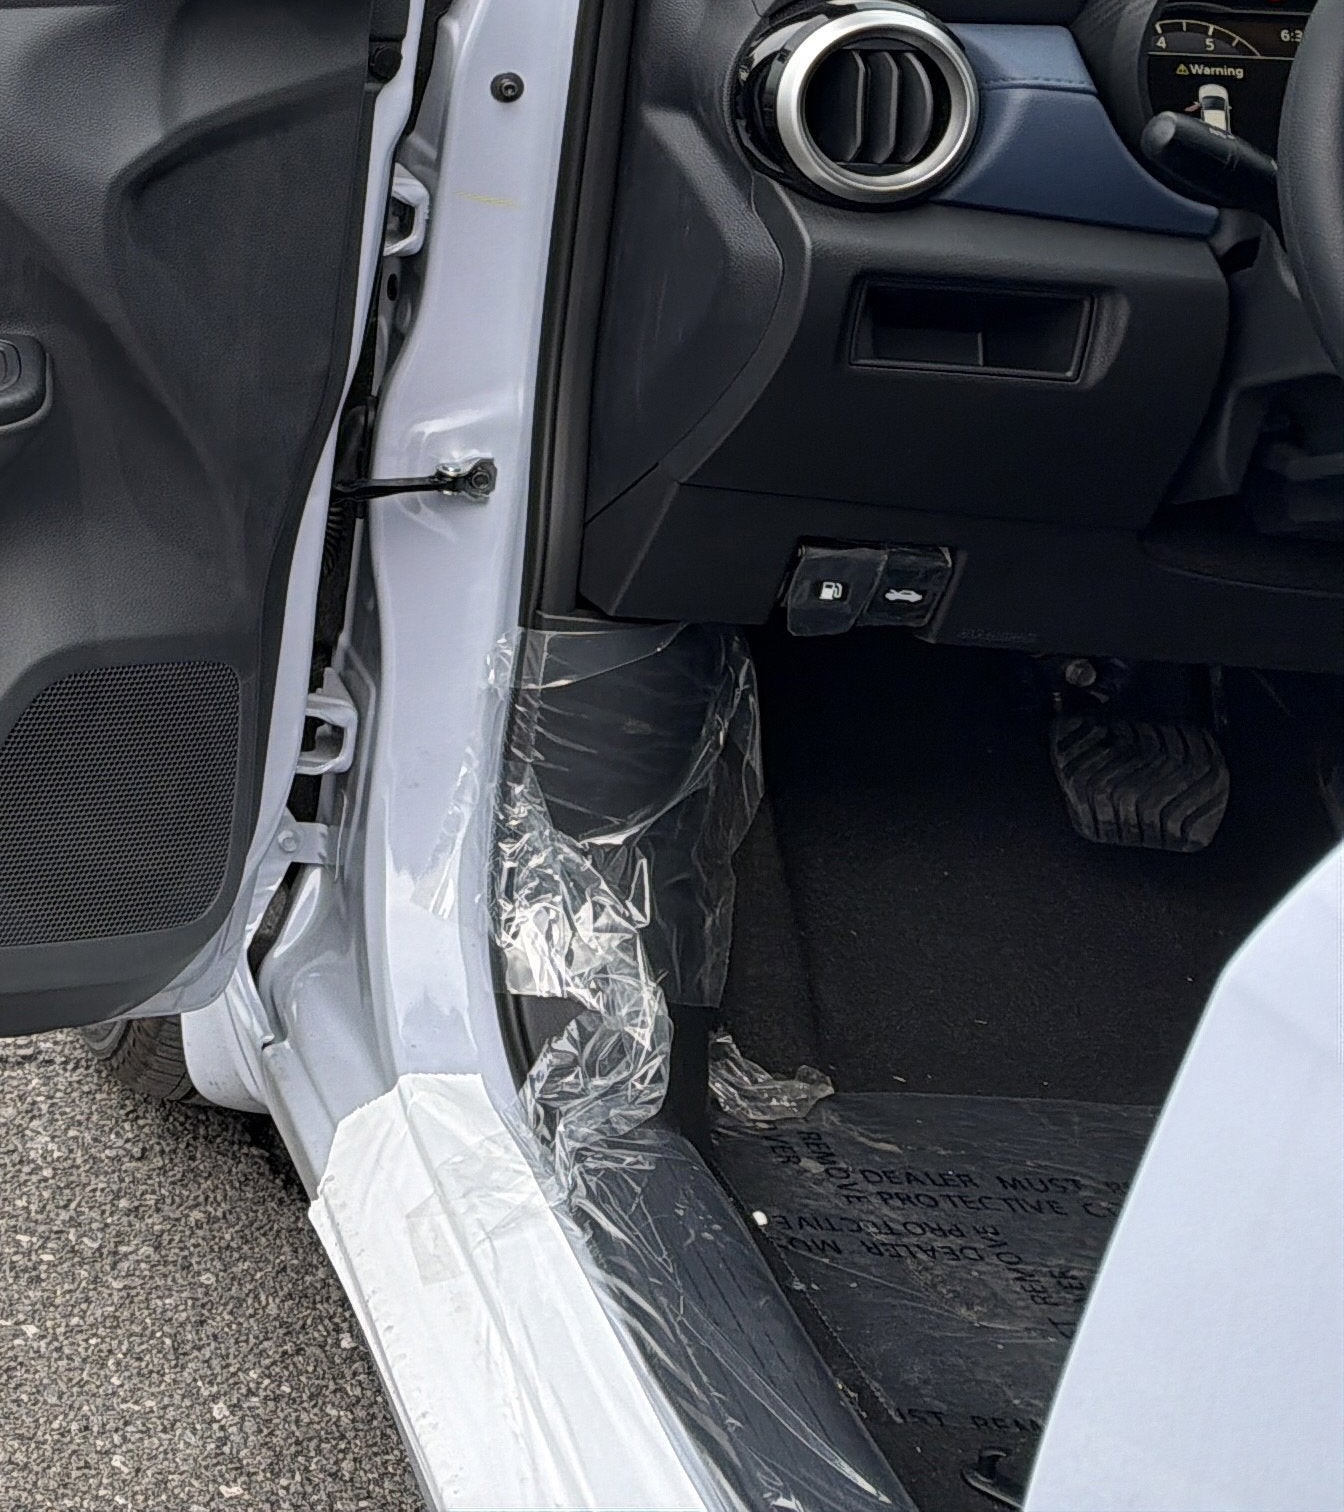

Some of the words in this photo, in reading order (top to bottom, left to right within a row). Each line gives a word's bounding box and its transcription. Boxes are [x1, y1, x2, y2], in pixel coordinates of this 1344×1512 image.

[1156, 36, 1167, 49] 4
[1205, 38, 1215, 51] 5
[1190, 63, 1244, 79] Warning
[858, 1168, 980, 1189] DEALER
[996, 1174, 1083, 1193] MUST
[875, 1190, 1069, 1217] PROTECTIVE
[860, 1238, 985, 1262] DEALER
